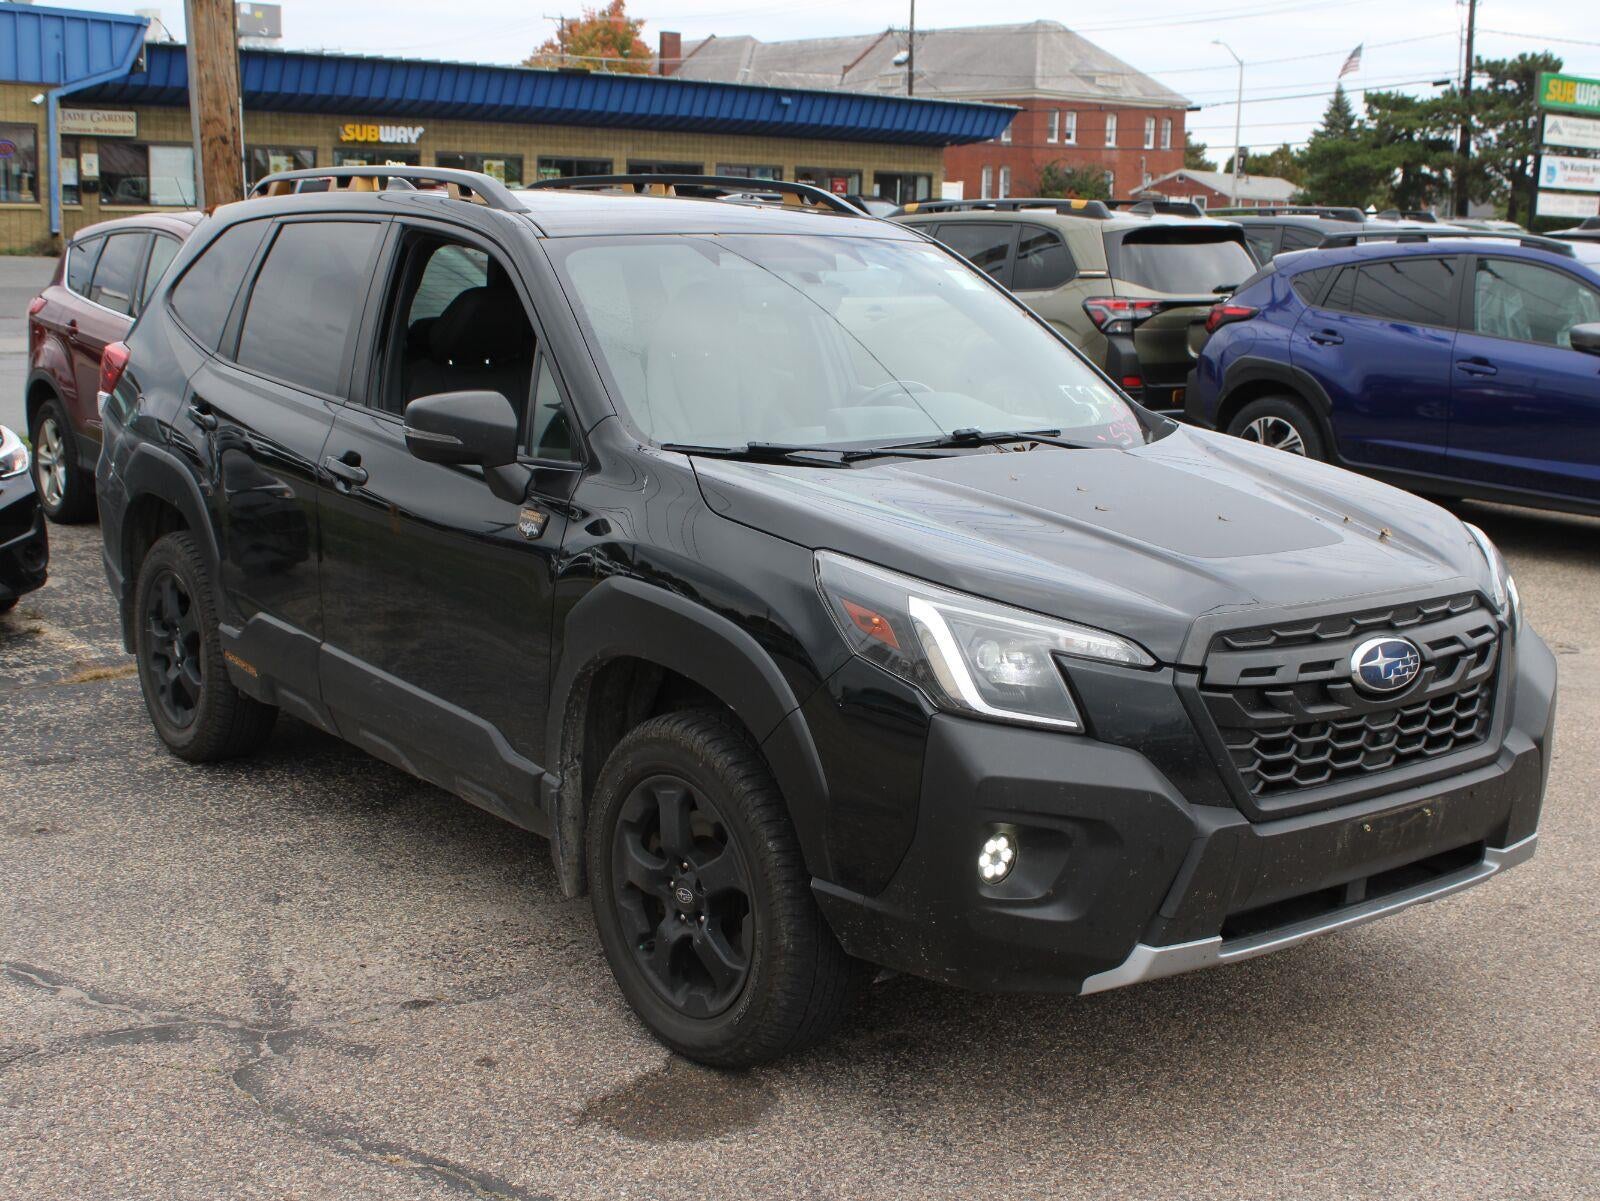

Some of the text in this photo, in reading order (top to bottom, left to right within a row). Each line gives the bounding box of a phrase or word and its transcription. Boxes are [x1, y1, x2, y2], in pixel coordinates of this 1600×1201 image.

[1545, 79, 1600, 106] SUBWA
[61, 110, 135, 123] JADE GARDEN
[341, 123, 425, 144] SUBWAY
